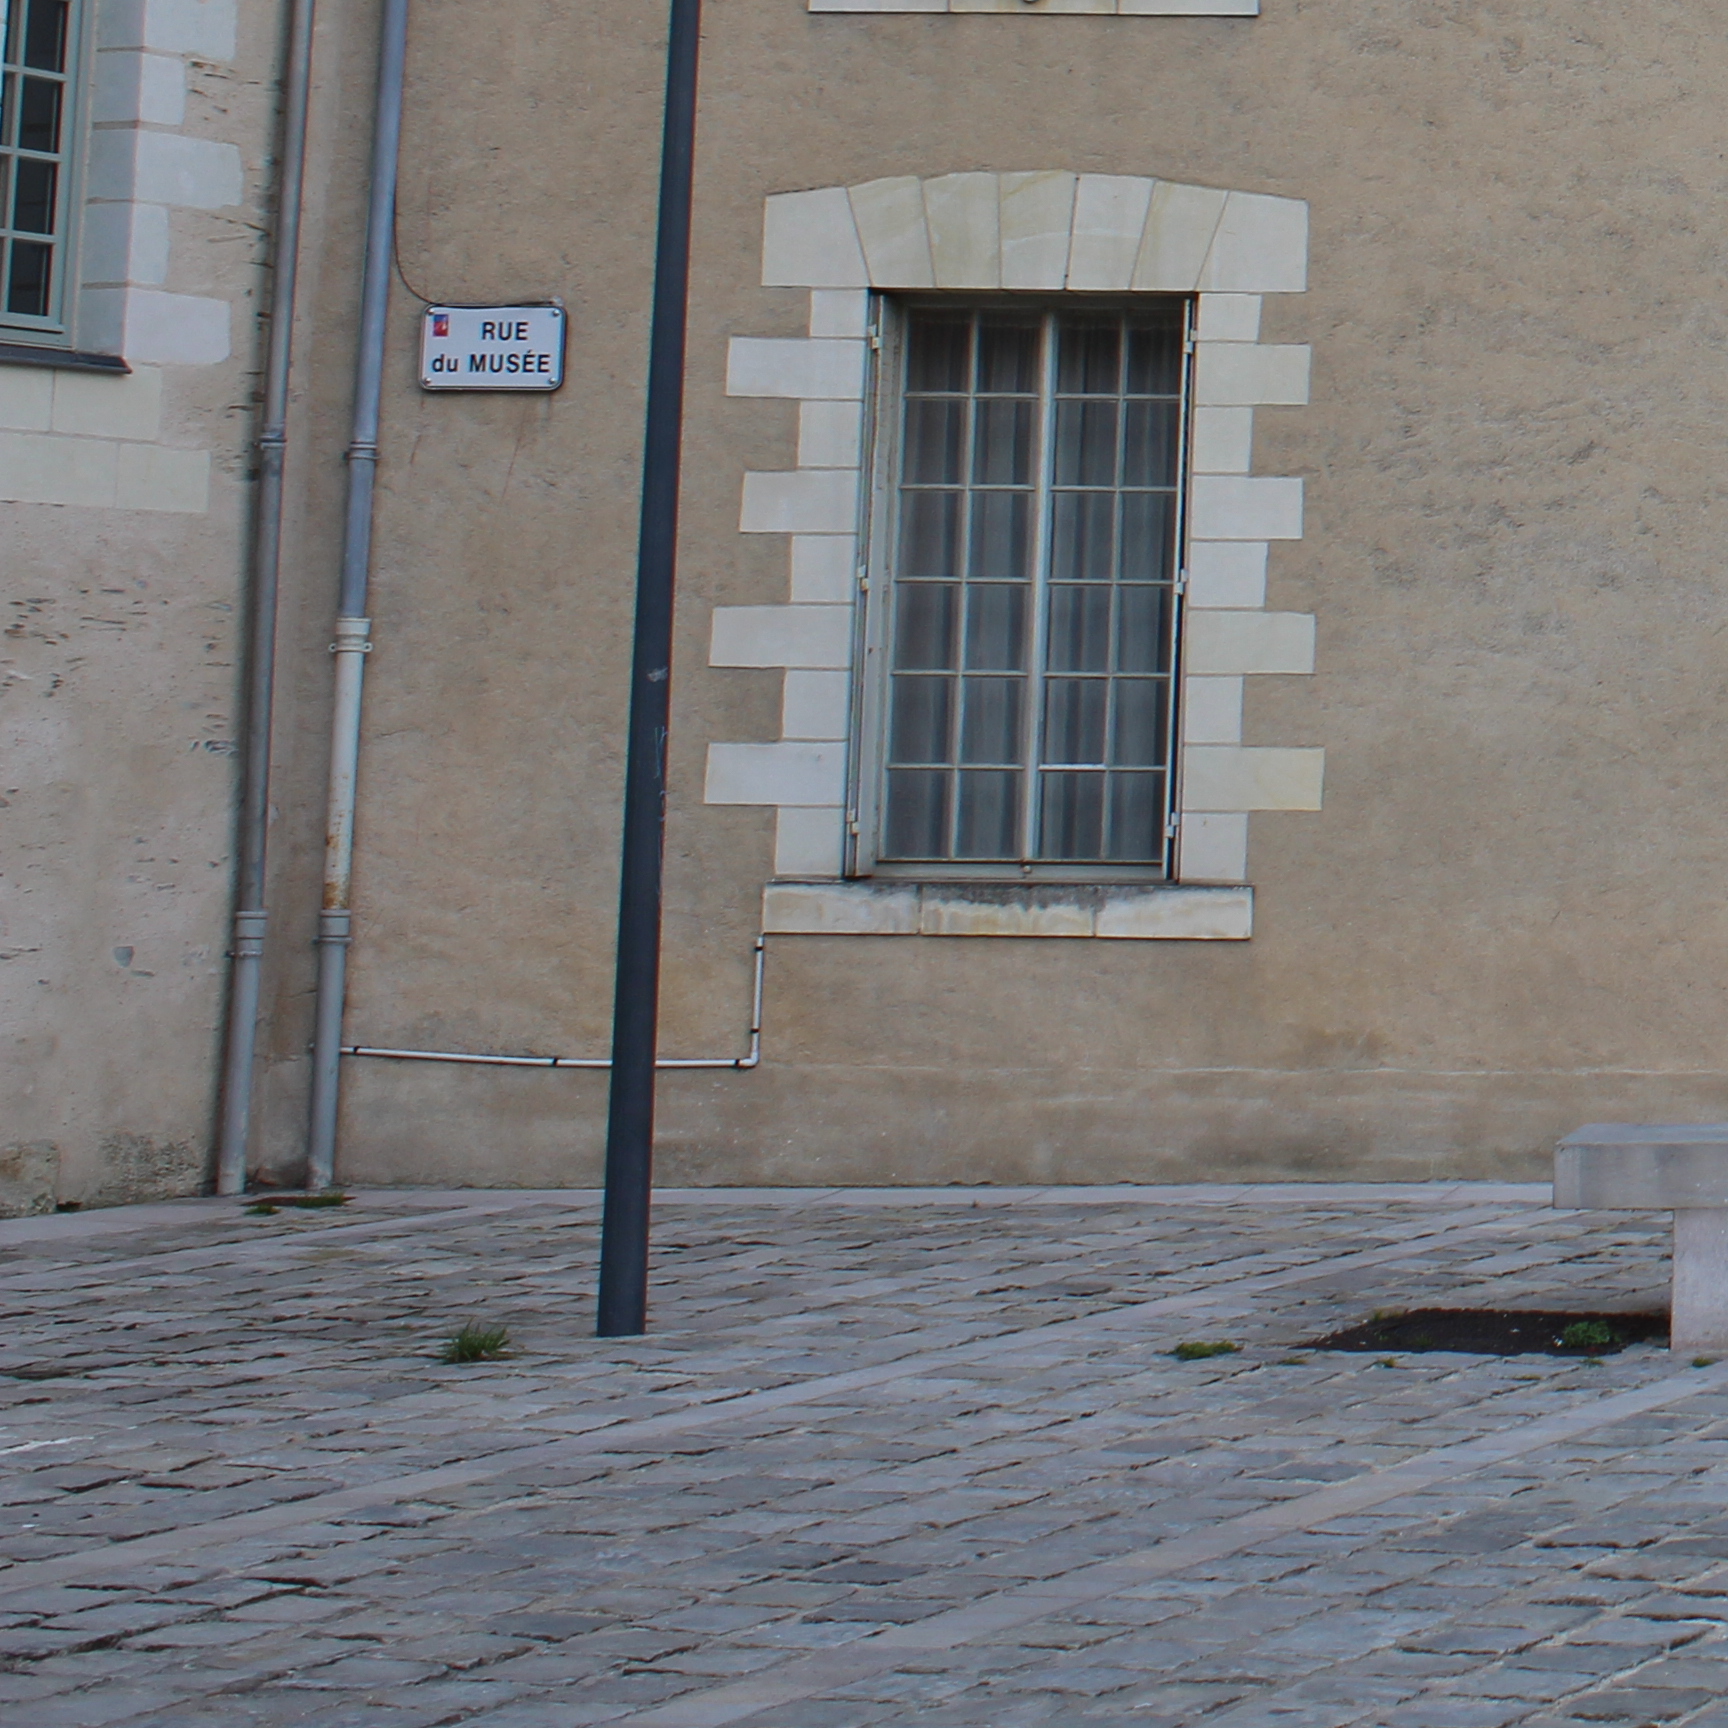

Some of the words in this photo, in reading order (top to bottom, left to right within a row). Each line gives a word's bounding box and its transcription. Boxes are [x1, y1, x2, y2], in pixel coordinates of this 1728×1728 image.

[481, 321, 529, 341] RUE
[432, 353, 459, 373] du
[469, 349, 551, 373] MUSÉE
